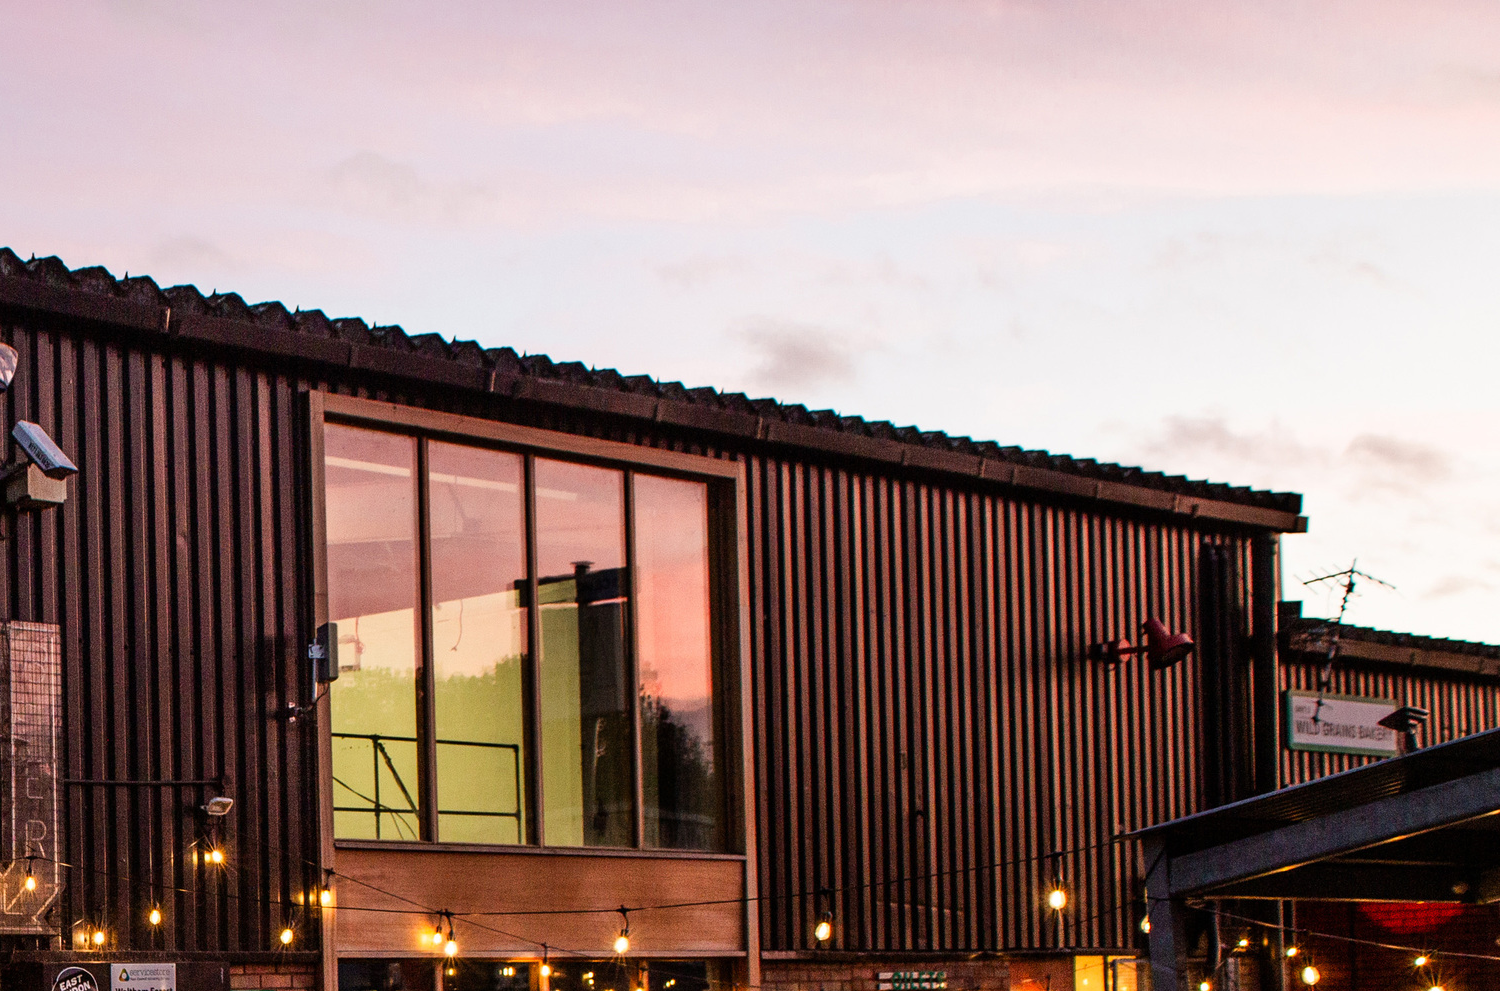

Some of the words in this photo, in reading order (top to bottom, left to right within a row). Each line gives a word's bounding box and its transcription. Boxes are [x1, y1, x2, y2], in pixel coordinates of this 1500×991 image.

[1296, 720, 1320, 736] WILD
[1323, 722, 1356, 739] GRAINS
[59, 974, 83, 991] EAST
